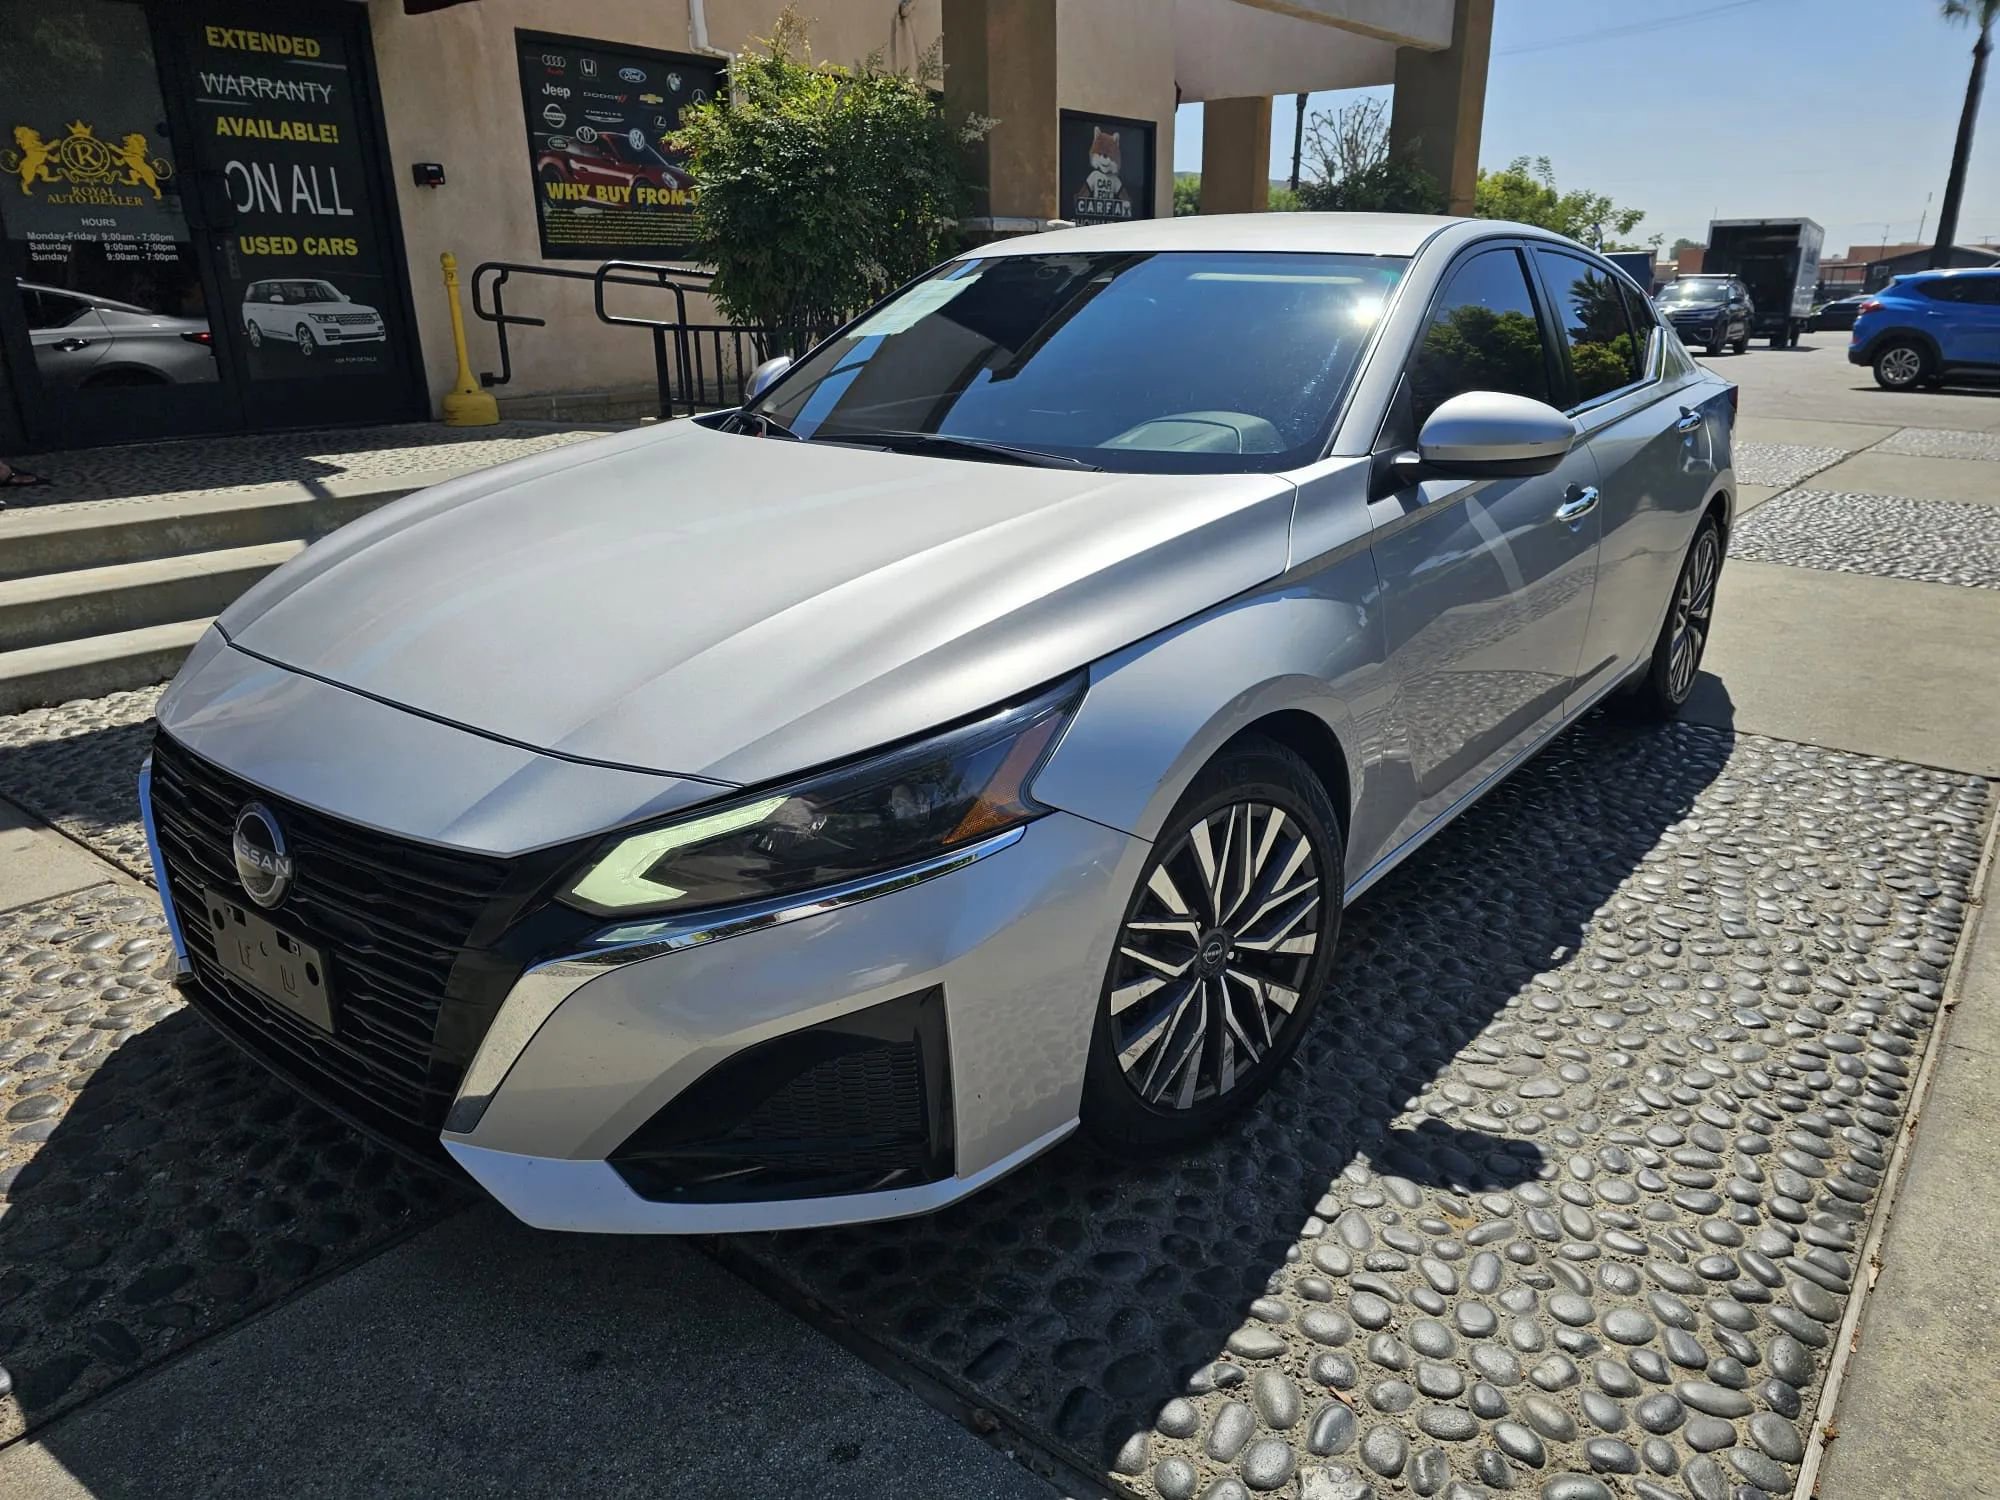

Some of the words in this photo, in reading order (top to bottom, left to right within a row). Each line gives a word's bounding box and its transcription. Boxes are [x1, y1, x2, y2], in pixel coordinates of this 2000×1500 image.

[205, 25, 321, 57] EXTENDED
[200, 71, 332, 104] WARRANTY
[542, 83, 571, 100] Jeep
[216, 116, 339, 144] AVAILABLE!
[74, 143, 98, 166] R
[71, 186, 115, 197] ROYAL
[224, 160, 283, 213] ON
[291, 164, 354, 216] ALL
[1097, 178, 1113, 190] CAR
[47, 194, 86, 205] AUTO
[90, 194, 144, 207] DEALER
[545, 182, 589, 200] WHY
[595, 183, 631, 203] BUY
[637, 187, 685, 206] FROM
[81, 217, 117, 227] HOURS
[26, 231, 97, 243] Monday-Friday
[101, 232, 135, 241] 9:00am
[141, 233, 174, 243] 7:00pm
[239, 236, 299, 255] USED
[303, 237, 359, 256] CARS
[29, 243, 72, 252] Saturday
[104, 243, 138, 251] 9:00am
[145, 243, 176, 252] 7:00pm
[31, 253, 68, 263] Sunday
[106, 253, 140, 261] 9:00am
[147, 253, 179, 263] 7:00pm
[238, 839, 289, 875] ISSAN
